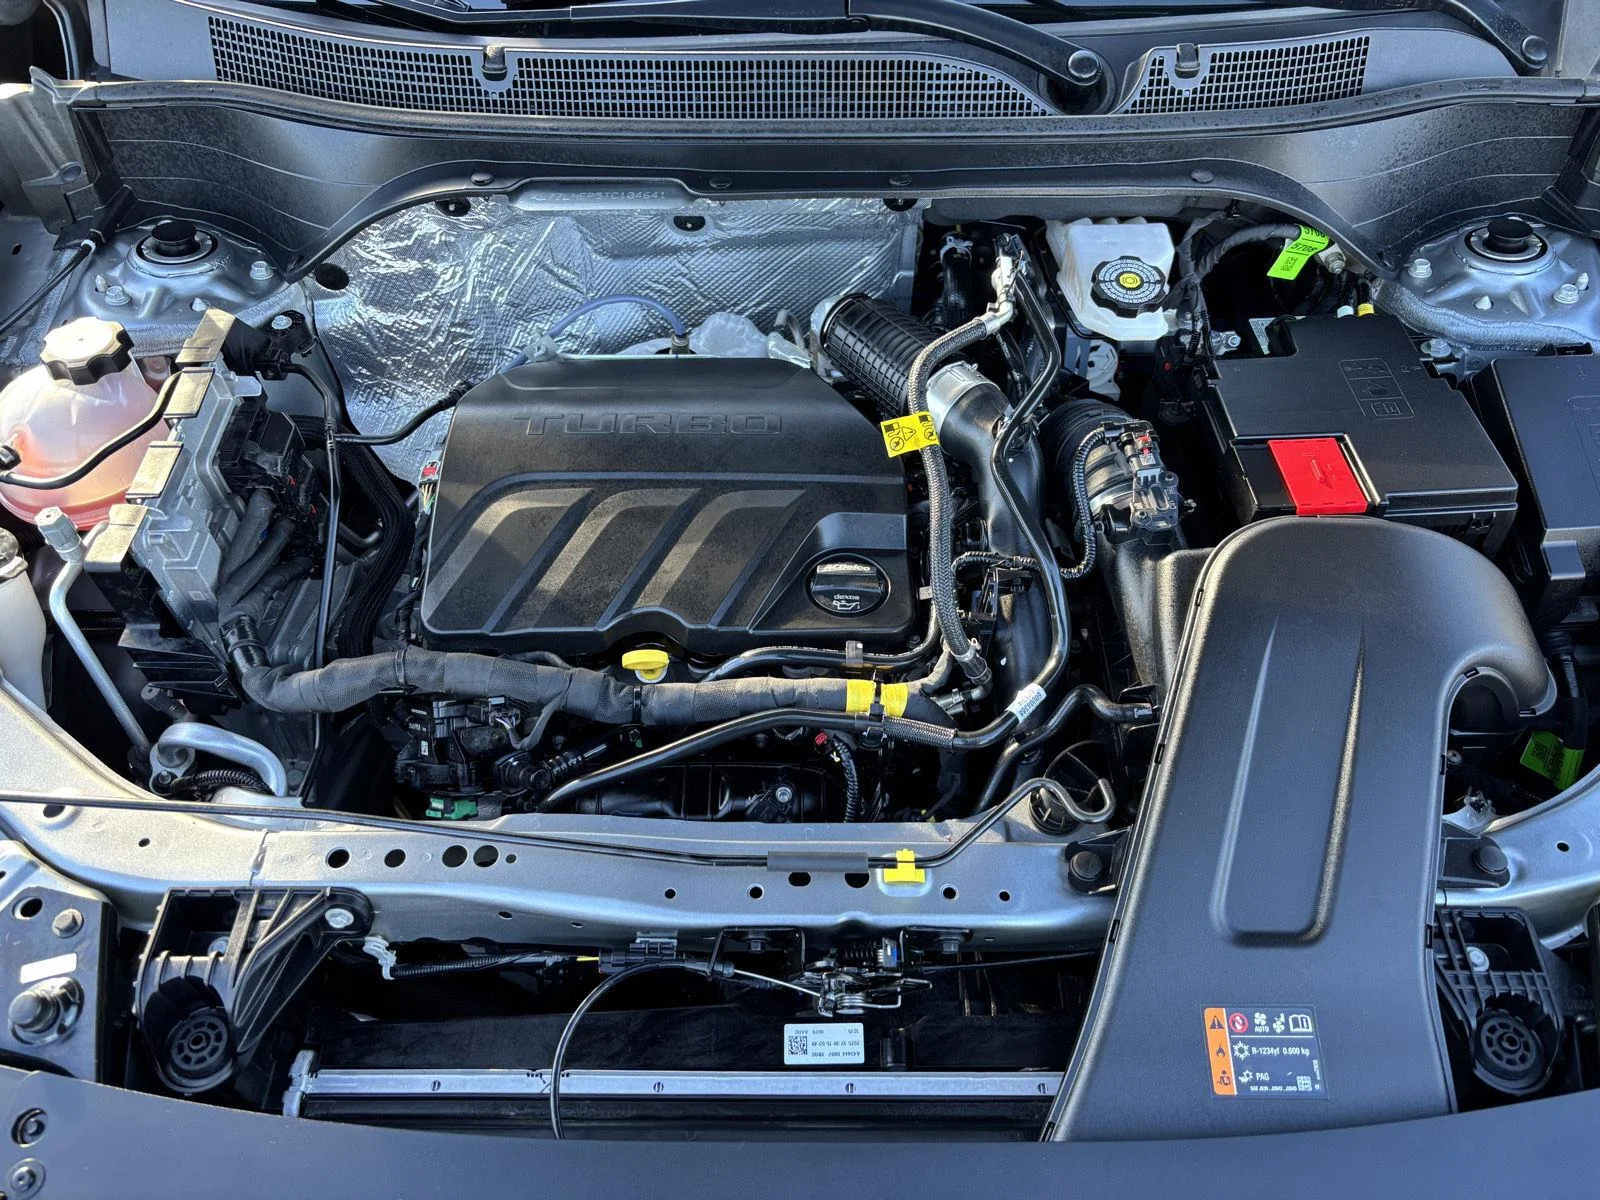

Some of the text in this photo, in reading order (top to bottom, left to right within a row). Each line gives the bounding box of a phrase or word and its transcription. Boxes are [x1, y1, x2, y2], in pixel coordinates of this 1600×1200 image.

[512, 413, 782, 435] TURBO
[1251, 1046, 1280, 1056] R-1234yf
[1301, 1046, 1310, 1056] kg
[1255, 1072, 1270, 1081] PAG
